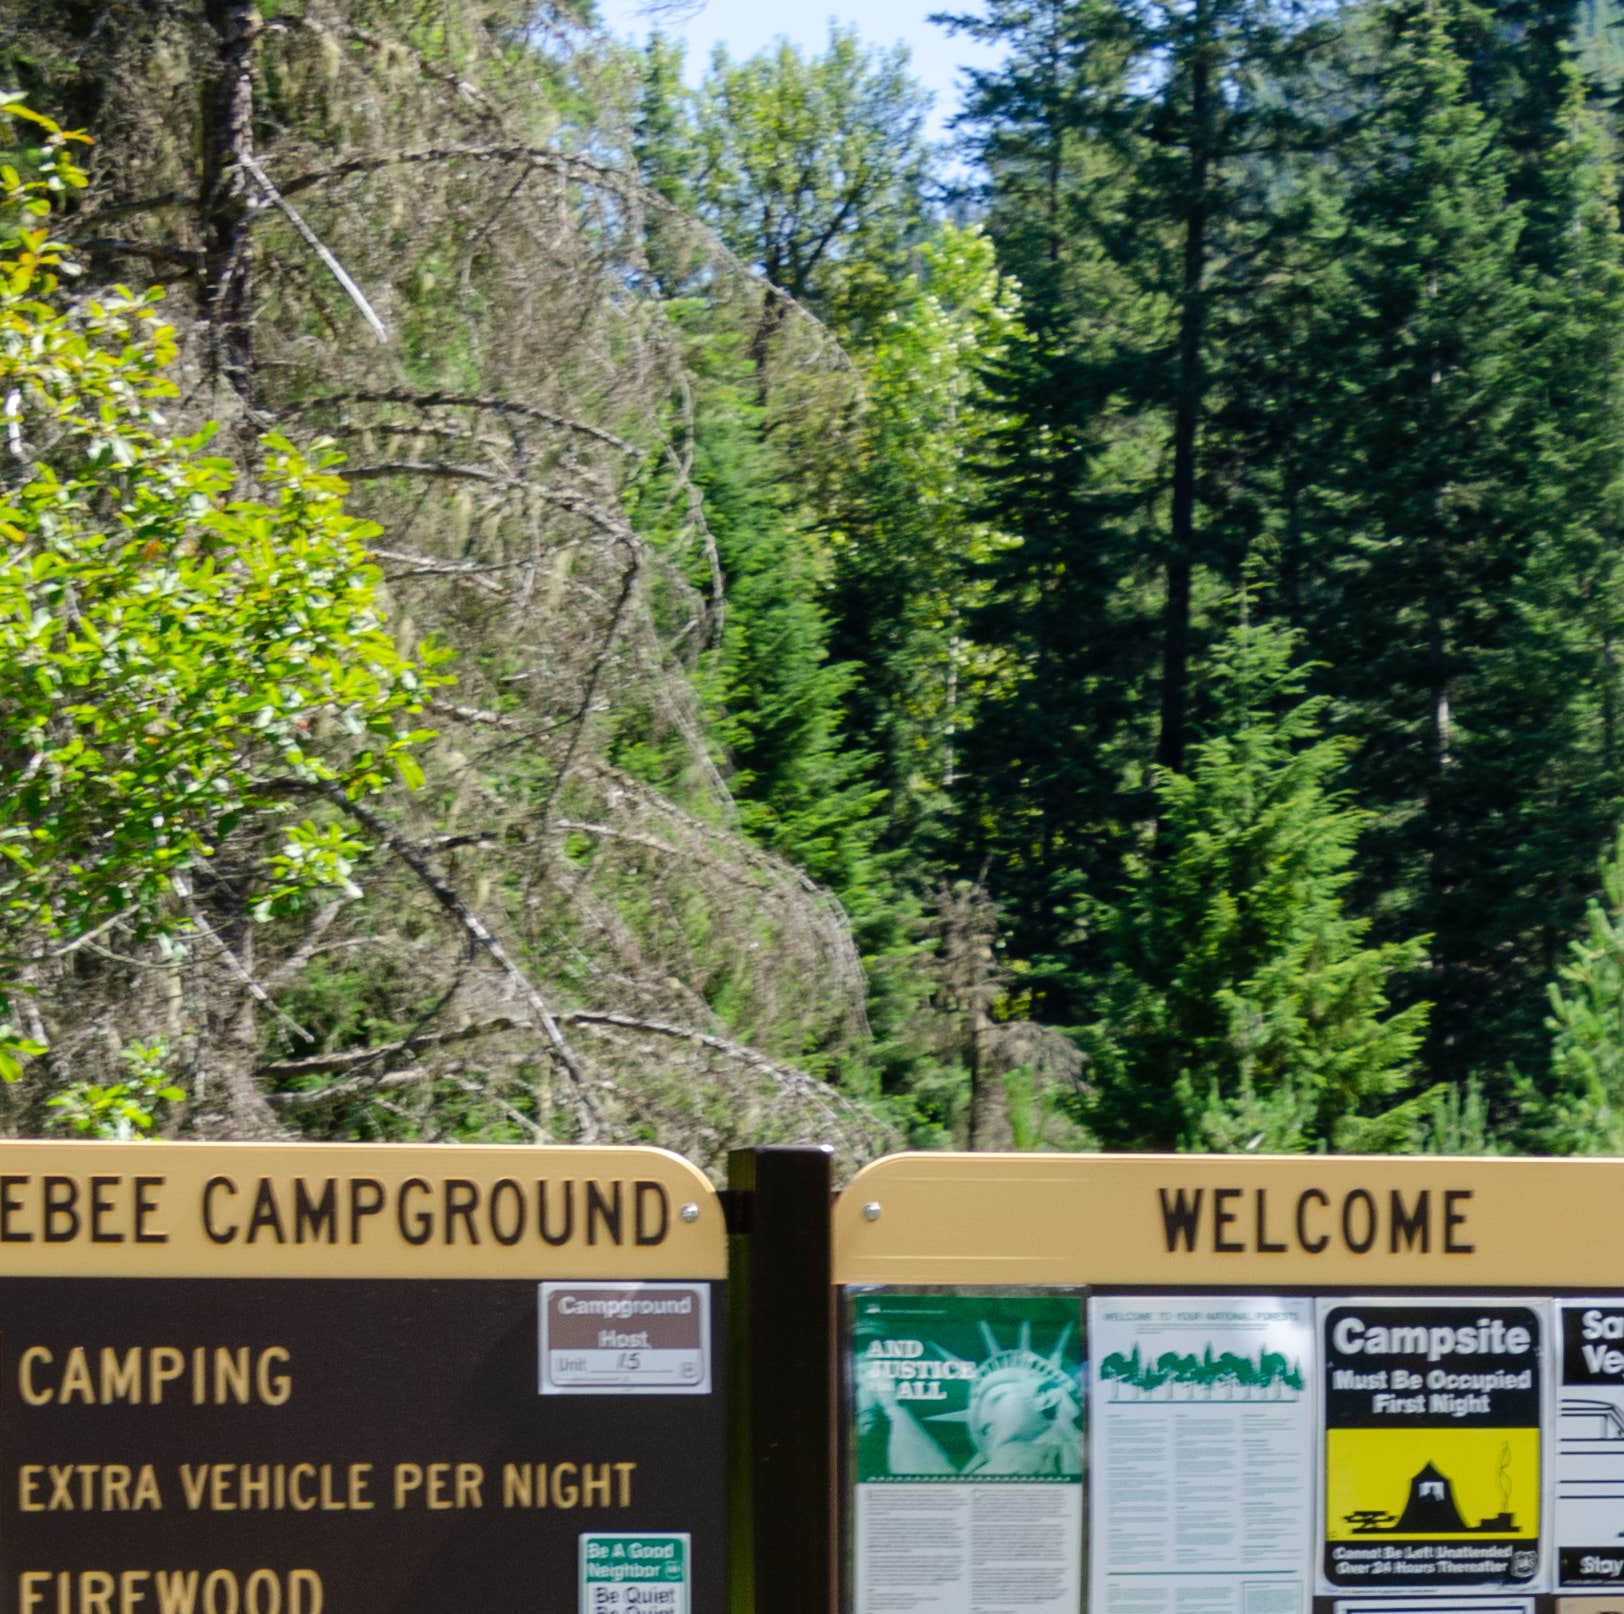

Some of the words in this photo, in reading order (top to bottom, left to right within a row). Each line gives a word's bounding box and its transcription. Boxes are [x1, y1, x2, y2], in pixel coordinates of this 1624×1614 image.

[201, 1175, 671, 1247] CAMPGROUND
[1157, 1187, 1475, 1254] WELCOME
[558, 1296, 692, 1319] Campground
[598, 1330, 649, 1350] Host
[1333, 1316, 1532, 1362] Campsite
[864, 1340, 924, 1359] AND
[18, 1346, 293, 1407] CAMPING
[867, 1361, 977, 1380] JUSTICE
[896, 1382, 948, 1400] ALL
[1332, 1369, 1388, 1390] Must
[1390, 1369, 1424, 1390] Be
[1426, 1369, 1532, 1393] Occupied
[1372, 1393, 1426, 1414] First
[1428, 1393, 1492, 1418] Night
[19, 1464, 163, 1512] EXTRA
[179, 1463, 375, 1512] VEHICLE
[393, 1463, 485, 1510] PER
[503, 1462, 638, 1509] NIGHT
[587, 1542, 609, 1559] Be
[612, 1542, 626, 1558] A
[628, 1542, 675, 1559] Good
[1333, 1546, 1382, 1560] Cannot
[1384, 1546, 1403, 1559] Be
[1435, 1544, 1514, 1558] Unattended
[587, 1562, 661, 1582] Neighbor
[1334, 1562, 1370, 1575] Over
[1371, 1562, 1392, 1574] 24
[1393, 1561, 1436, 1574] Hours
[1438, 1560, 1509, 1573] Thereafter
[1580, 1556, 1624, 1577] Stay
[595, 1586, 619, 1603] Be
[626, 1586, 676, 1604] Quiet
